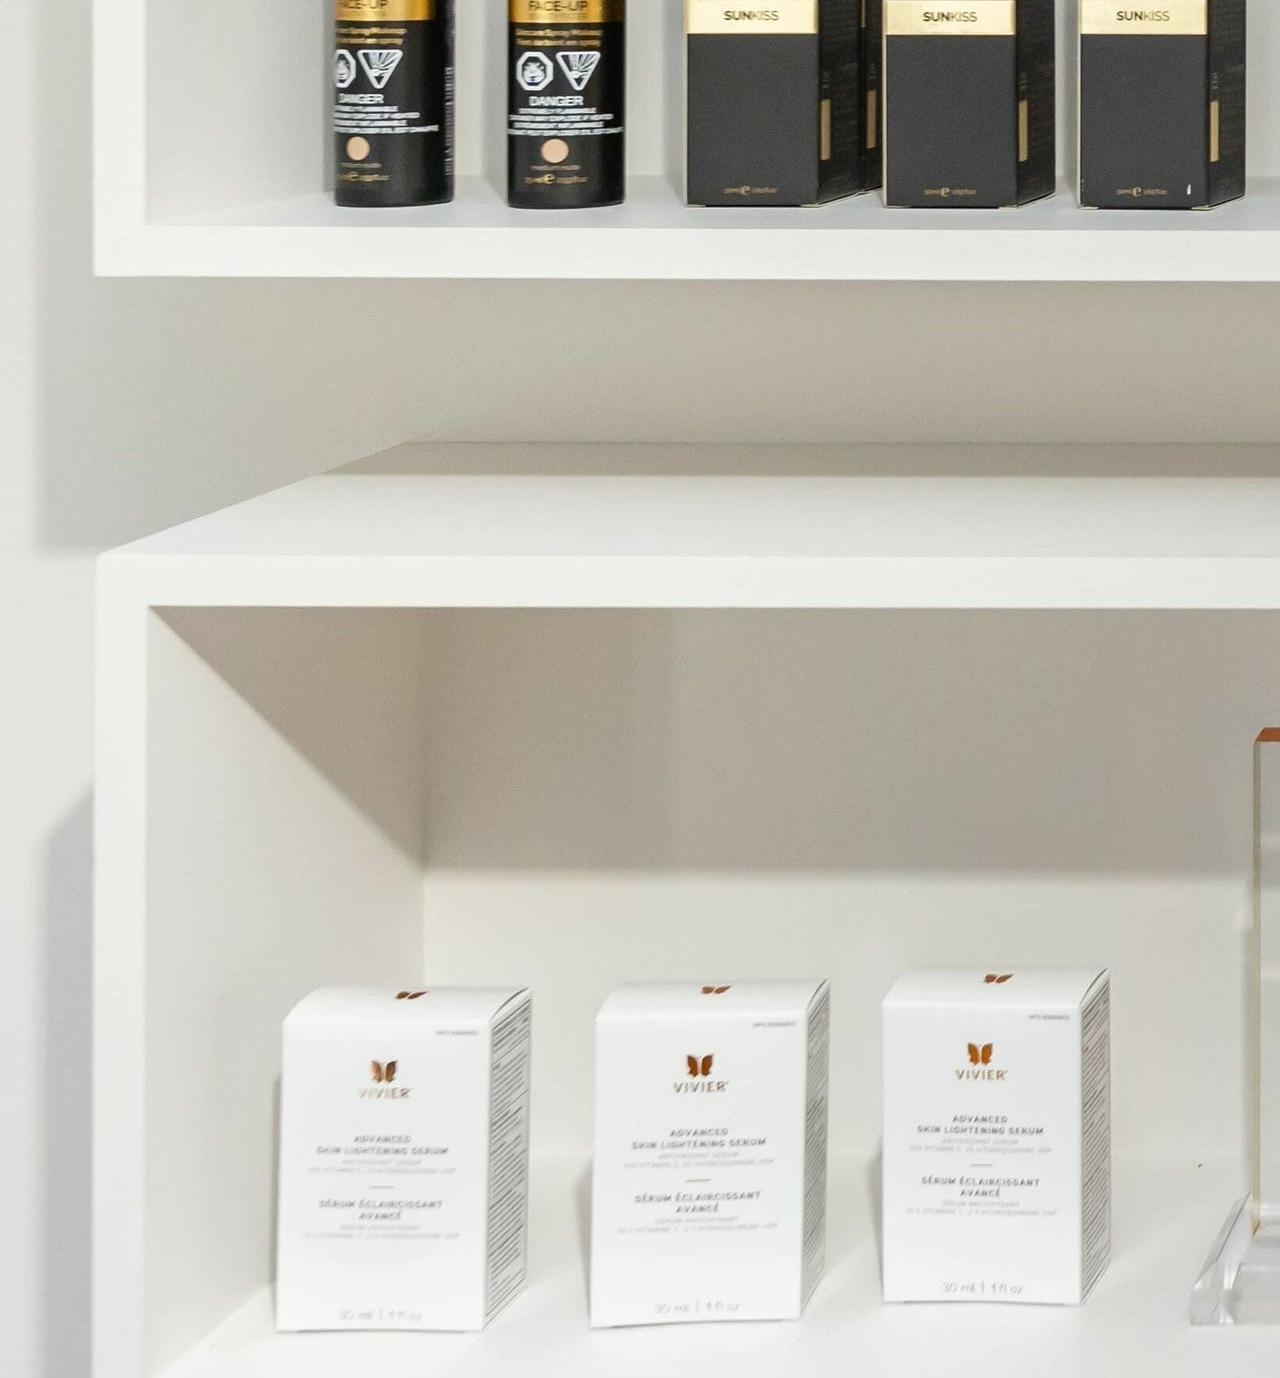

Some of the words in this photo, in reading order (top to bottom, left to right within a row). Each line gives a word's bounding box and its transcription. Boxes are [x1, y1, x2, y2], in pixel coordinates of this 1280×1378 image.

[724, 10, 779, 21] SUNKISS
[922, 11, 977, 23] SUNKISS
[1116, 11, 1169, 22] SUNKISS
[529, 96, 584, 106] DANGER
[956, 1069, 1007, 1080] VIVIER
[673, 1081, 728, 1093] VIVIER
[952, 1115, 1008, 1124] ADVANCED
[917, 1125, 941, 1134] SKIN
[944, 1125, 1005, 1135] LIGHTENING
[1008, 1126, 1044, 1135] SERUM
[921, 1175, 955, 1185] SÉRUM
[959, 1176, 1039, 1187] ÉCLAIRCISSANT
[960, 1187, 1000, 1198] AVANCÉ
